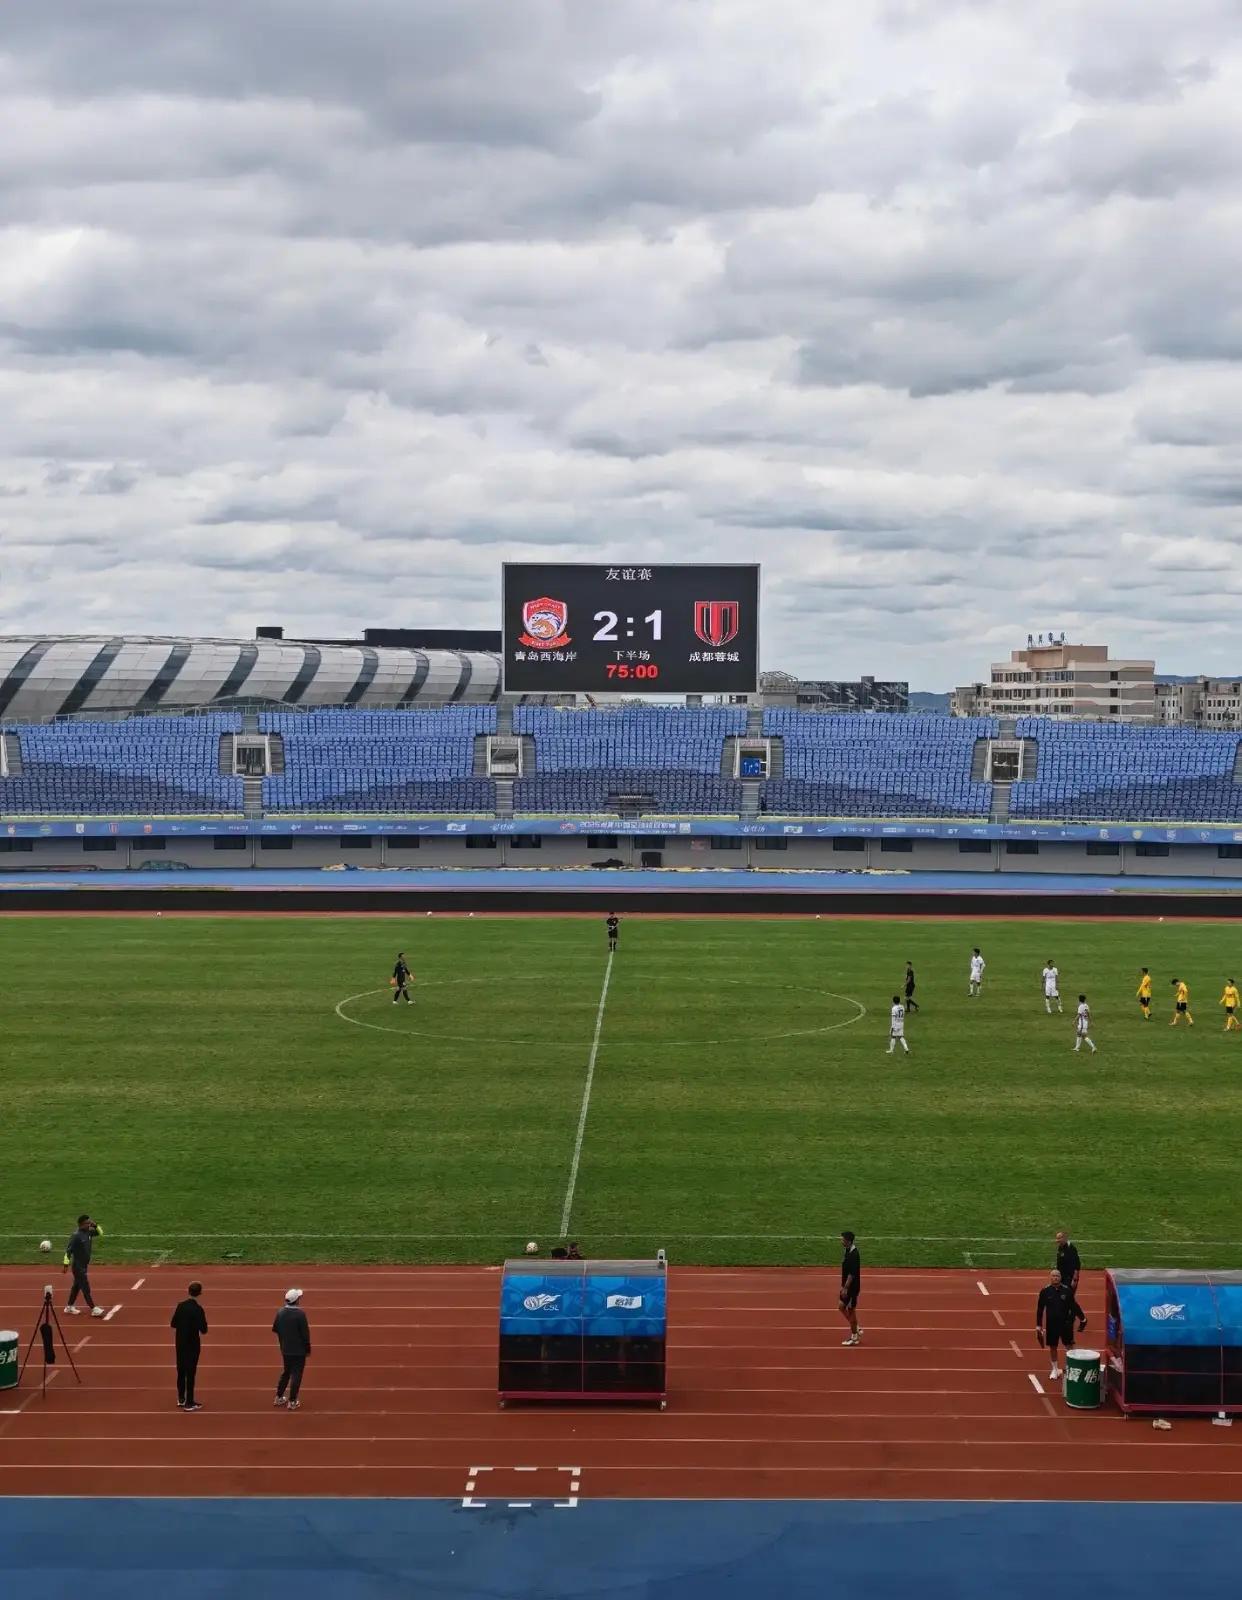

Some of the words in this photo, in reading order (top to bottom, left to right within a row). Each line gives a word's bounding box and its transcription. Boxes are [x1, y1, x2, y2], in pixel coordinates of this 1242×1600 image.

[605, 568, 652, 581] 友谊赛
[592, 609, 662, 641] 2:1
[514, 651, 577, 662] 青岛西海岸
[613, 650, 651, 661] 下半场
[688, 651, 740, 662] 成都蓉城
[606, 664, 659, 679] 75:00
